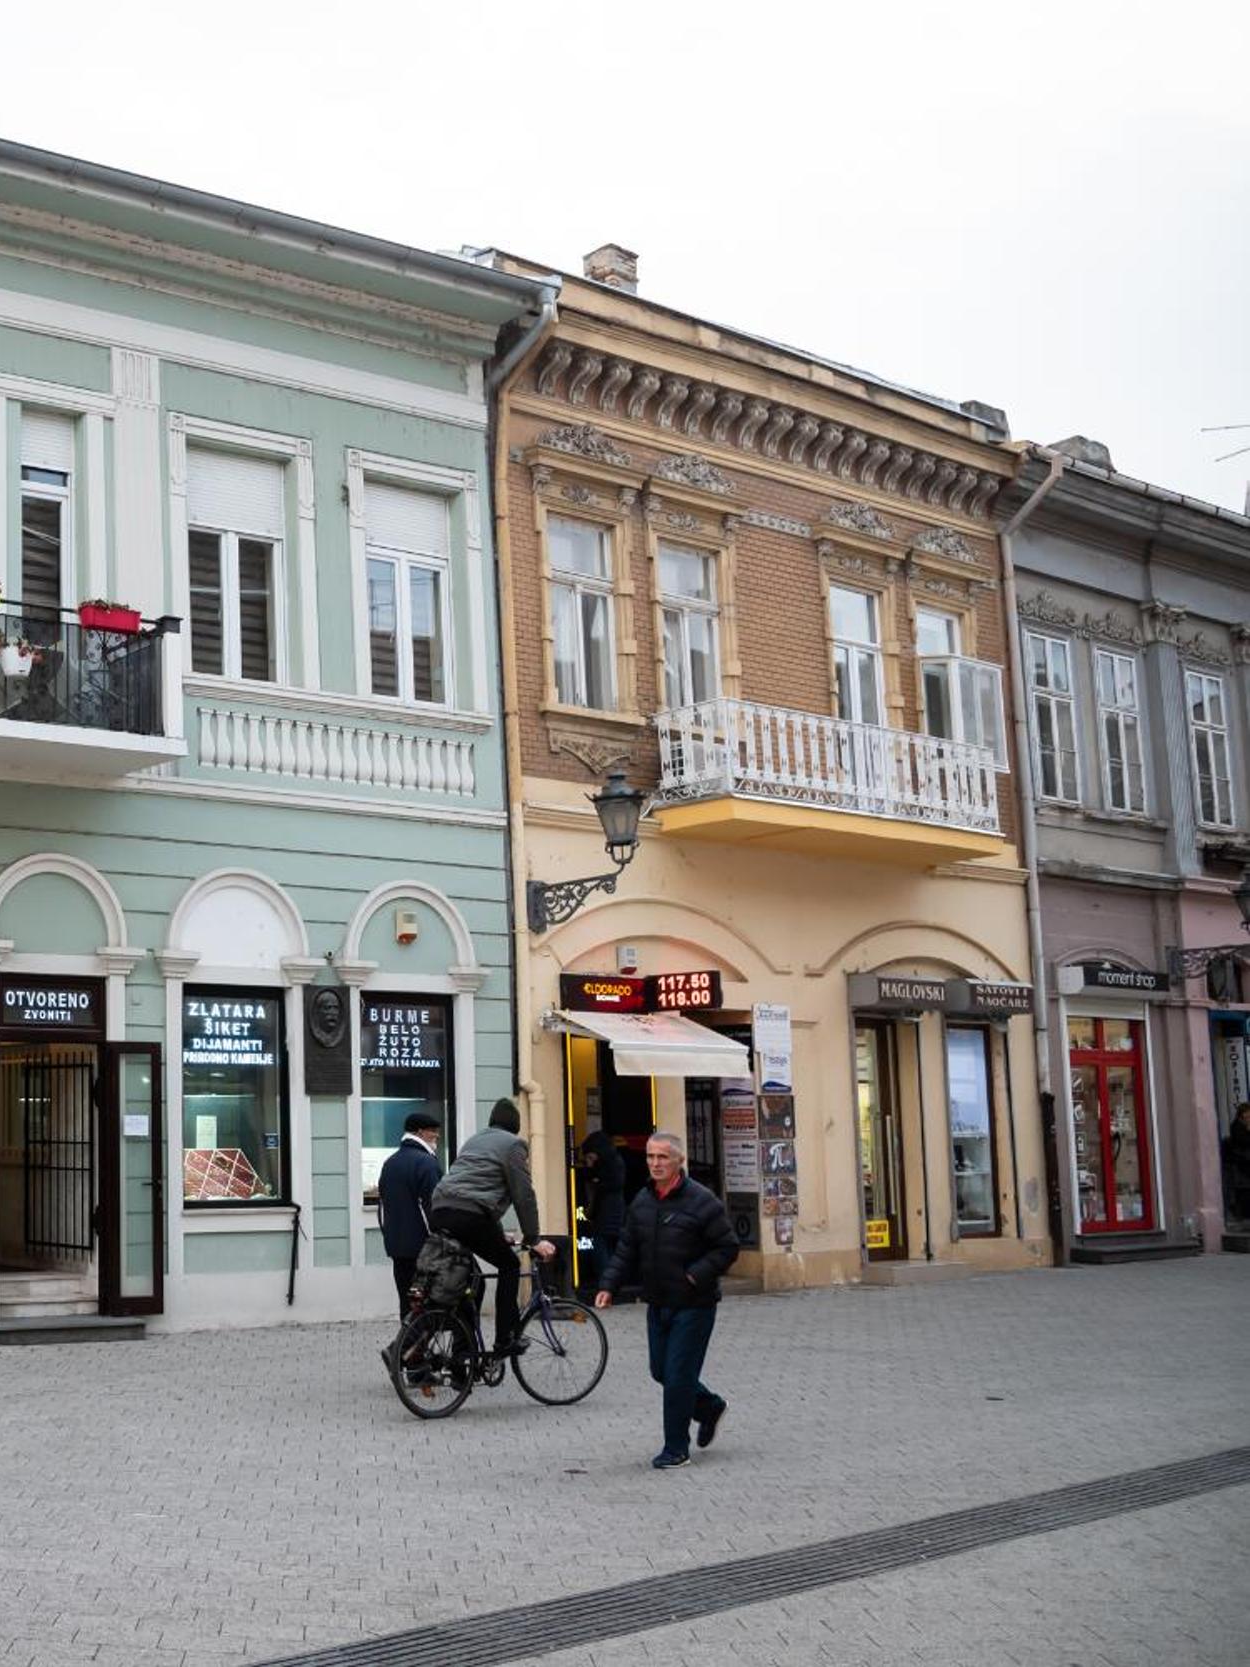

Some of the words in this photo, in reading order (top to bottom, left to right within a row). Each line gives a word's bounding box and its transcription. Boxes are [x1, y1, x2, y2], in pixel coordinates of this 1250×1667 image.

[658, 973, 710, 991] 117.50
[1098, 971, 1135, 986] moment
[1135, 974, 1156, 989] shop
[5, 991, 90, 1009] OTVORENO
[658, 990, 711, 1007] 118.00
[881, 982, 945, 1001] MAGLOVSKI
[24, 1010, 71, 1020] ZVONITI
[188, 1002, 266, 1019] ZLATARA
[370, 1008, 430, 1024] BURME
[204, 1018, 251, 1036] ŠIKET
[379, 1024, 421, 1035] BELO
[192, 1038, 263, 1051] DIJAMANTI
[379, 1047, 422, 1058] ROZA
